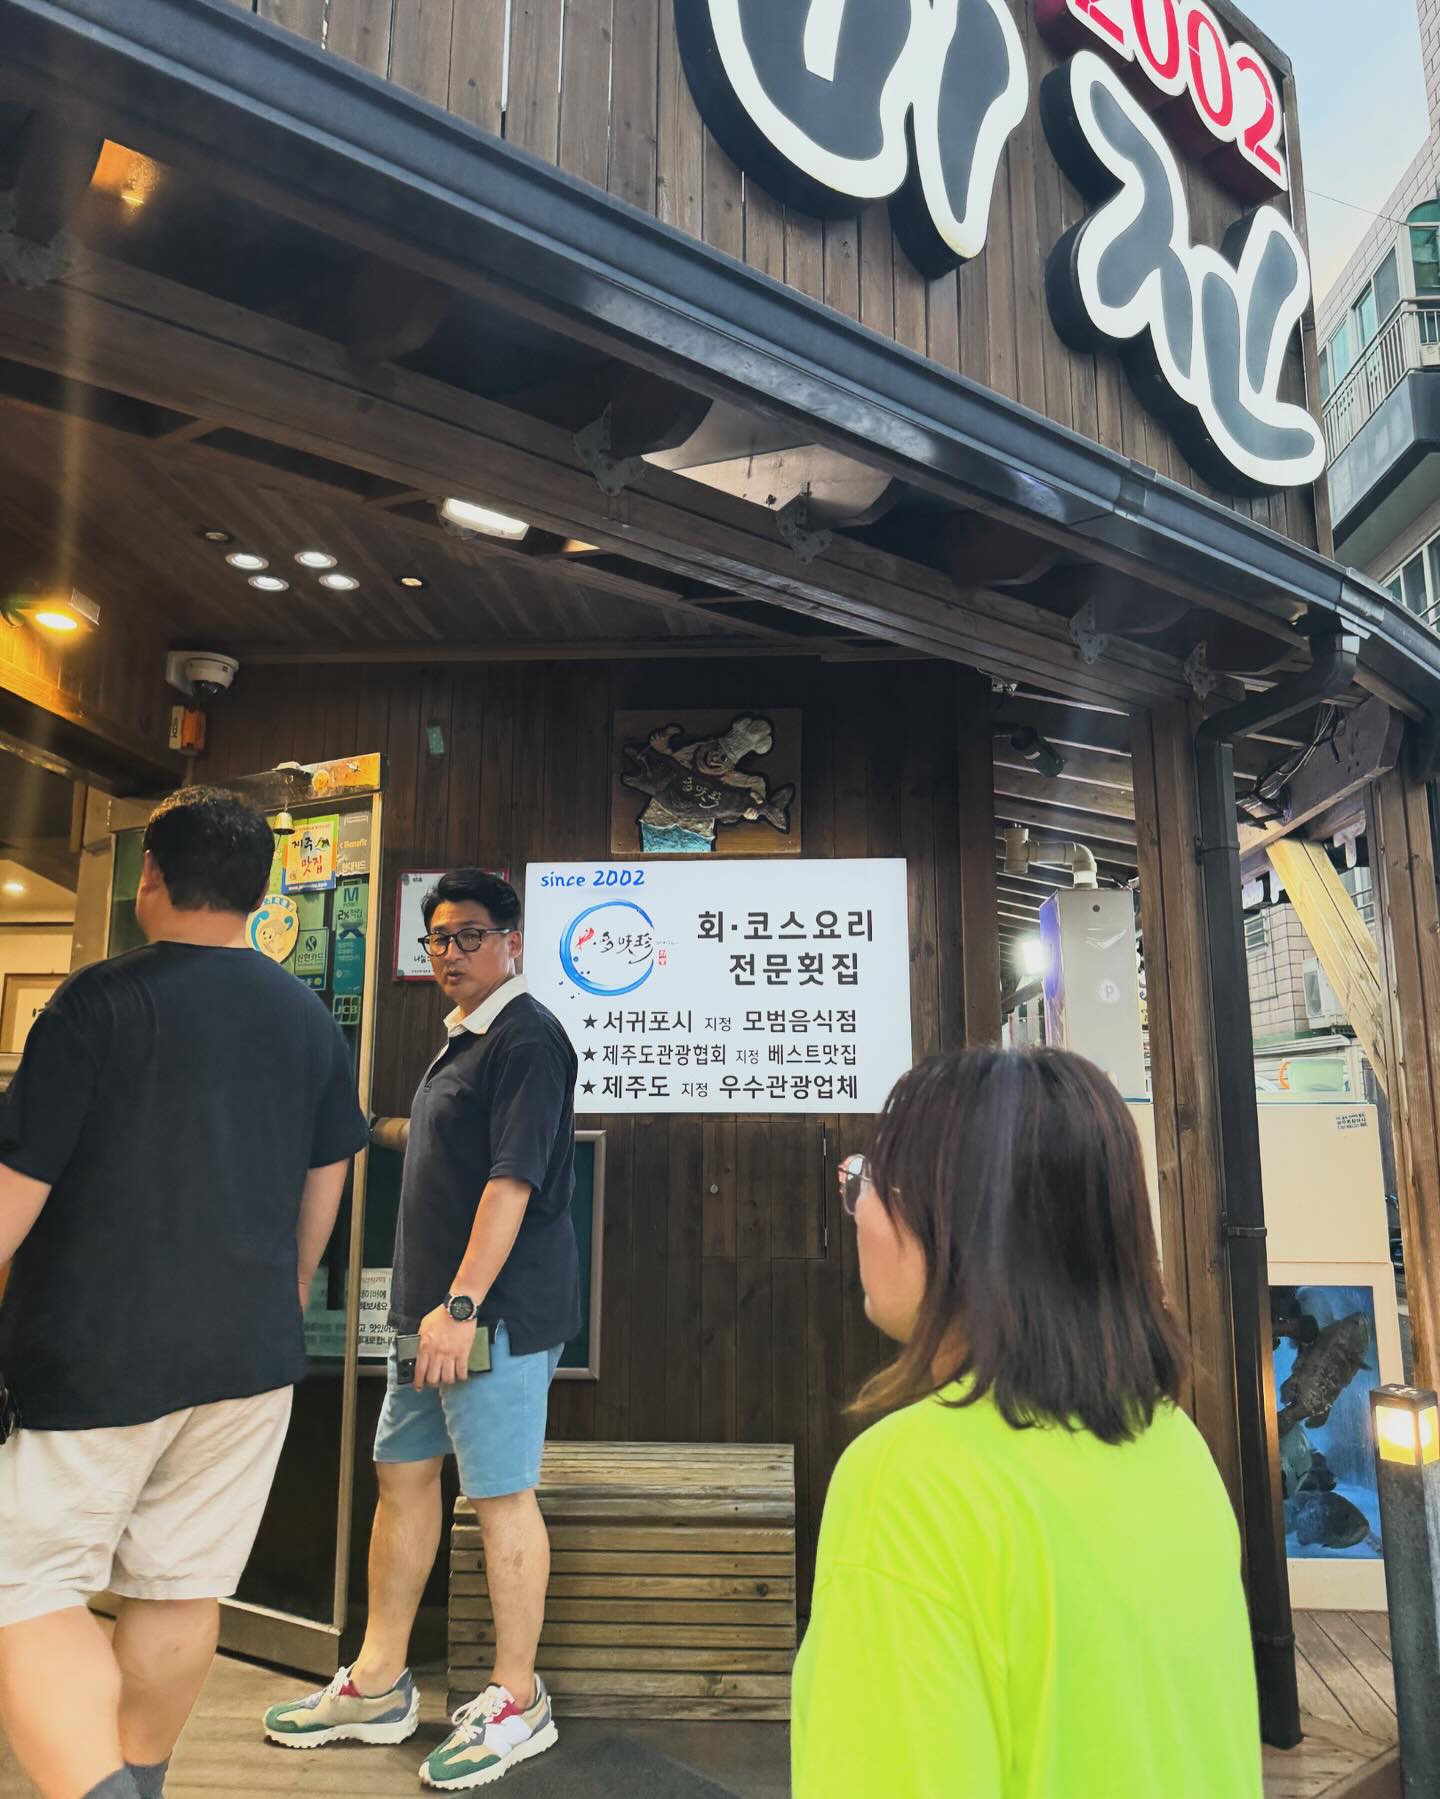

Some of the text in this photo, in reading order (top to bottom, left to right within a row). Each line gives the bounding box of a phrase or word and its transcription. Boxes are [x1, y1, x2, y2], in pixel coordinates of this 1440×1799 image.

[302, 856, 323, 876] 맛집
[541, 870, 645, 887] since 2002
[344, 887, 359, 902] M
[729, 952, 859, 986] 전문횟집
[334, 1005, 358, 1015] JCB
[603, 1009, 856, 1033] 서귀포시 지정 모범음식점
[602, 1044, 856, 1065] 제주도관광협회 지정 베스트맛집
[601, 1075, 858, 1099] 제주도 지정 우수관광업체
